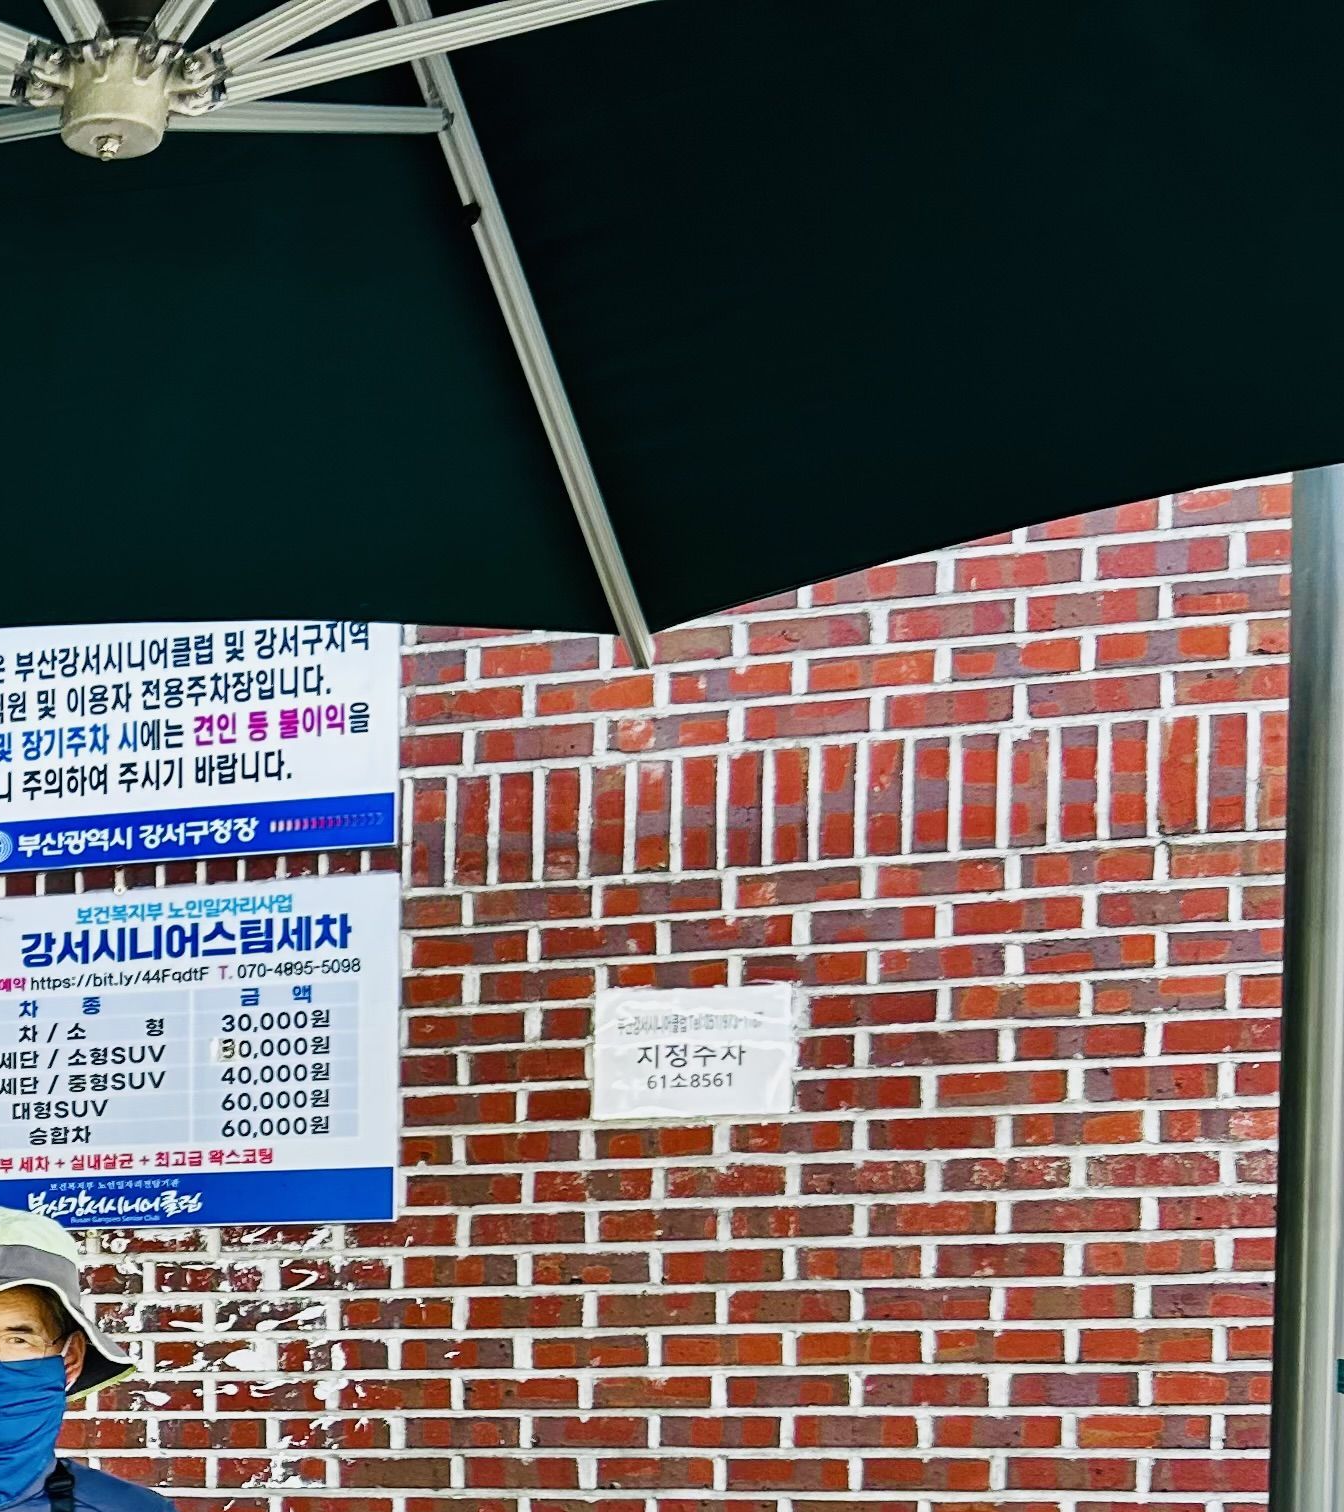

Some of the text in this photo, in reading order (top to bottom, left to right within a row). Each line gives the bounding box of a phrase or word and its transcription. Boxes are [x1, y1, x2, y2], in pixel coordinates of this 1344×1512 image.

[15, 632, 214, 682] 부산강서시니어클럽
[224, 629, 245, 664] 및
[254, 621, 370, 660] 강서구지역
[37, 688, 57, 721] 및
[67, 681, 132, 717] 이용자
[141, 664, 332, 711] 전용주차장입니다.
[21, 723, 110, 761] 장기주차
[118, 718, 184, 753] 시에는
[193, 712, 237, 747] 견인
[247, 710, 269, 742] 등
[278, 701, 371, 740] 불이익을
[22, 763, 108, 801] 주의하여
[118, 757, 183, 793] 주시기
[195, 748, 292, 787] 바랍니다.
[17, 816, 260, 859] 부산광역시 강서구청장
[75, 893, 293, 925] 보건복지부 노인일자리사업
[21, 913, 353, 968] 강서시니어스팀세차
[218, 965, 233, 980] T.
[236, 957, 362, 979] 070-4895-5098
[19, 984, 313, 1019] 차 종 금 액
[18, 1024, 38, 1043] 차
[66, 1022, 87, 1041] 소
[144, 1017, 165, 1037] 형
[221, 1009, 330, 1033] 30,000원
[67, 1044, 166, 1067] 소형SUV
[67, 1070, 166, 1094] 중형SUV
[221, 1062, 330, 1086] 40,000원
[647, 1072, 733, 1090] 61소8561
[12, 1088, 330, 1121] 대형SUV 60,000원
[28, 1115, 330, 1147] 승합차 60,000원
[18, 1154, 50, 1173] 세차
[69, 1151, 134, 1172] 실내살균
[154, 1148, 202, 1168] 최고급
